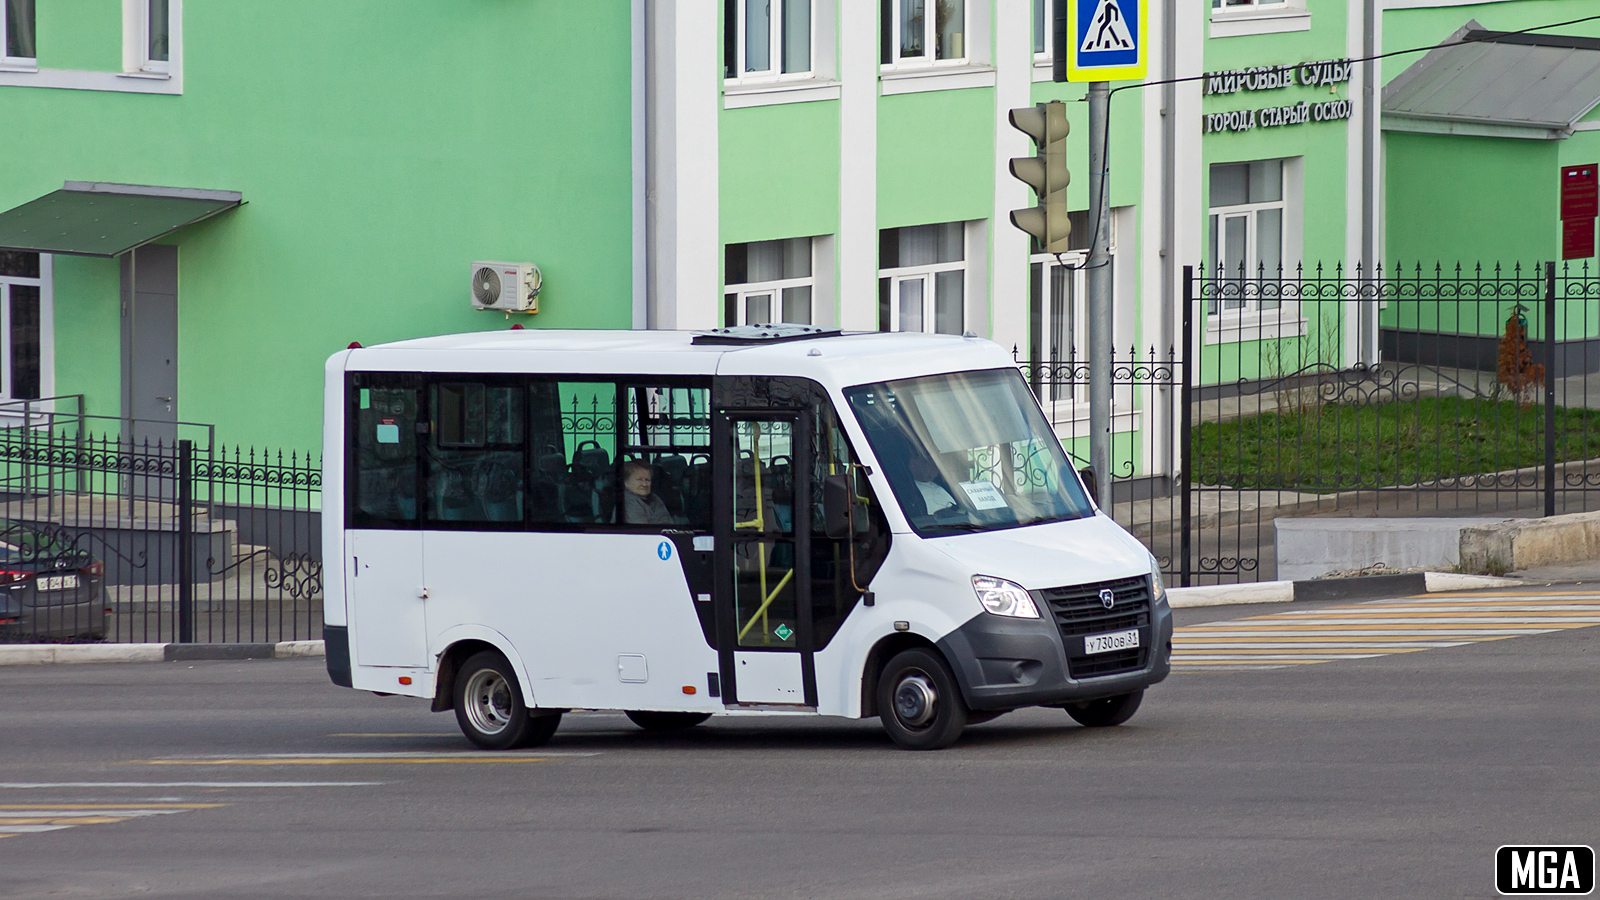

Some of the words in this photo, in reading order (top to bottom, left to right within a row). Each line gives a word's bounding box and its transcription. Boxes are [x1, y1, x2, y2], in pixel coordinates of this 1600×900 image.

[1206, 64, 1293, 95] МИРОВЫЕ
[1299, 58, 1354, 88] СУДЬИ
[1207, 110, 1257, 133] ГОРОДА
[1260, 102, 1310, 127] СТАРЫЙ
[1314, 99, 1354, 122] ОСКОЛ
